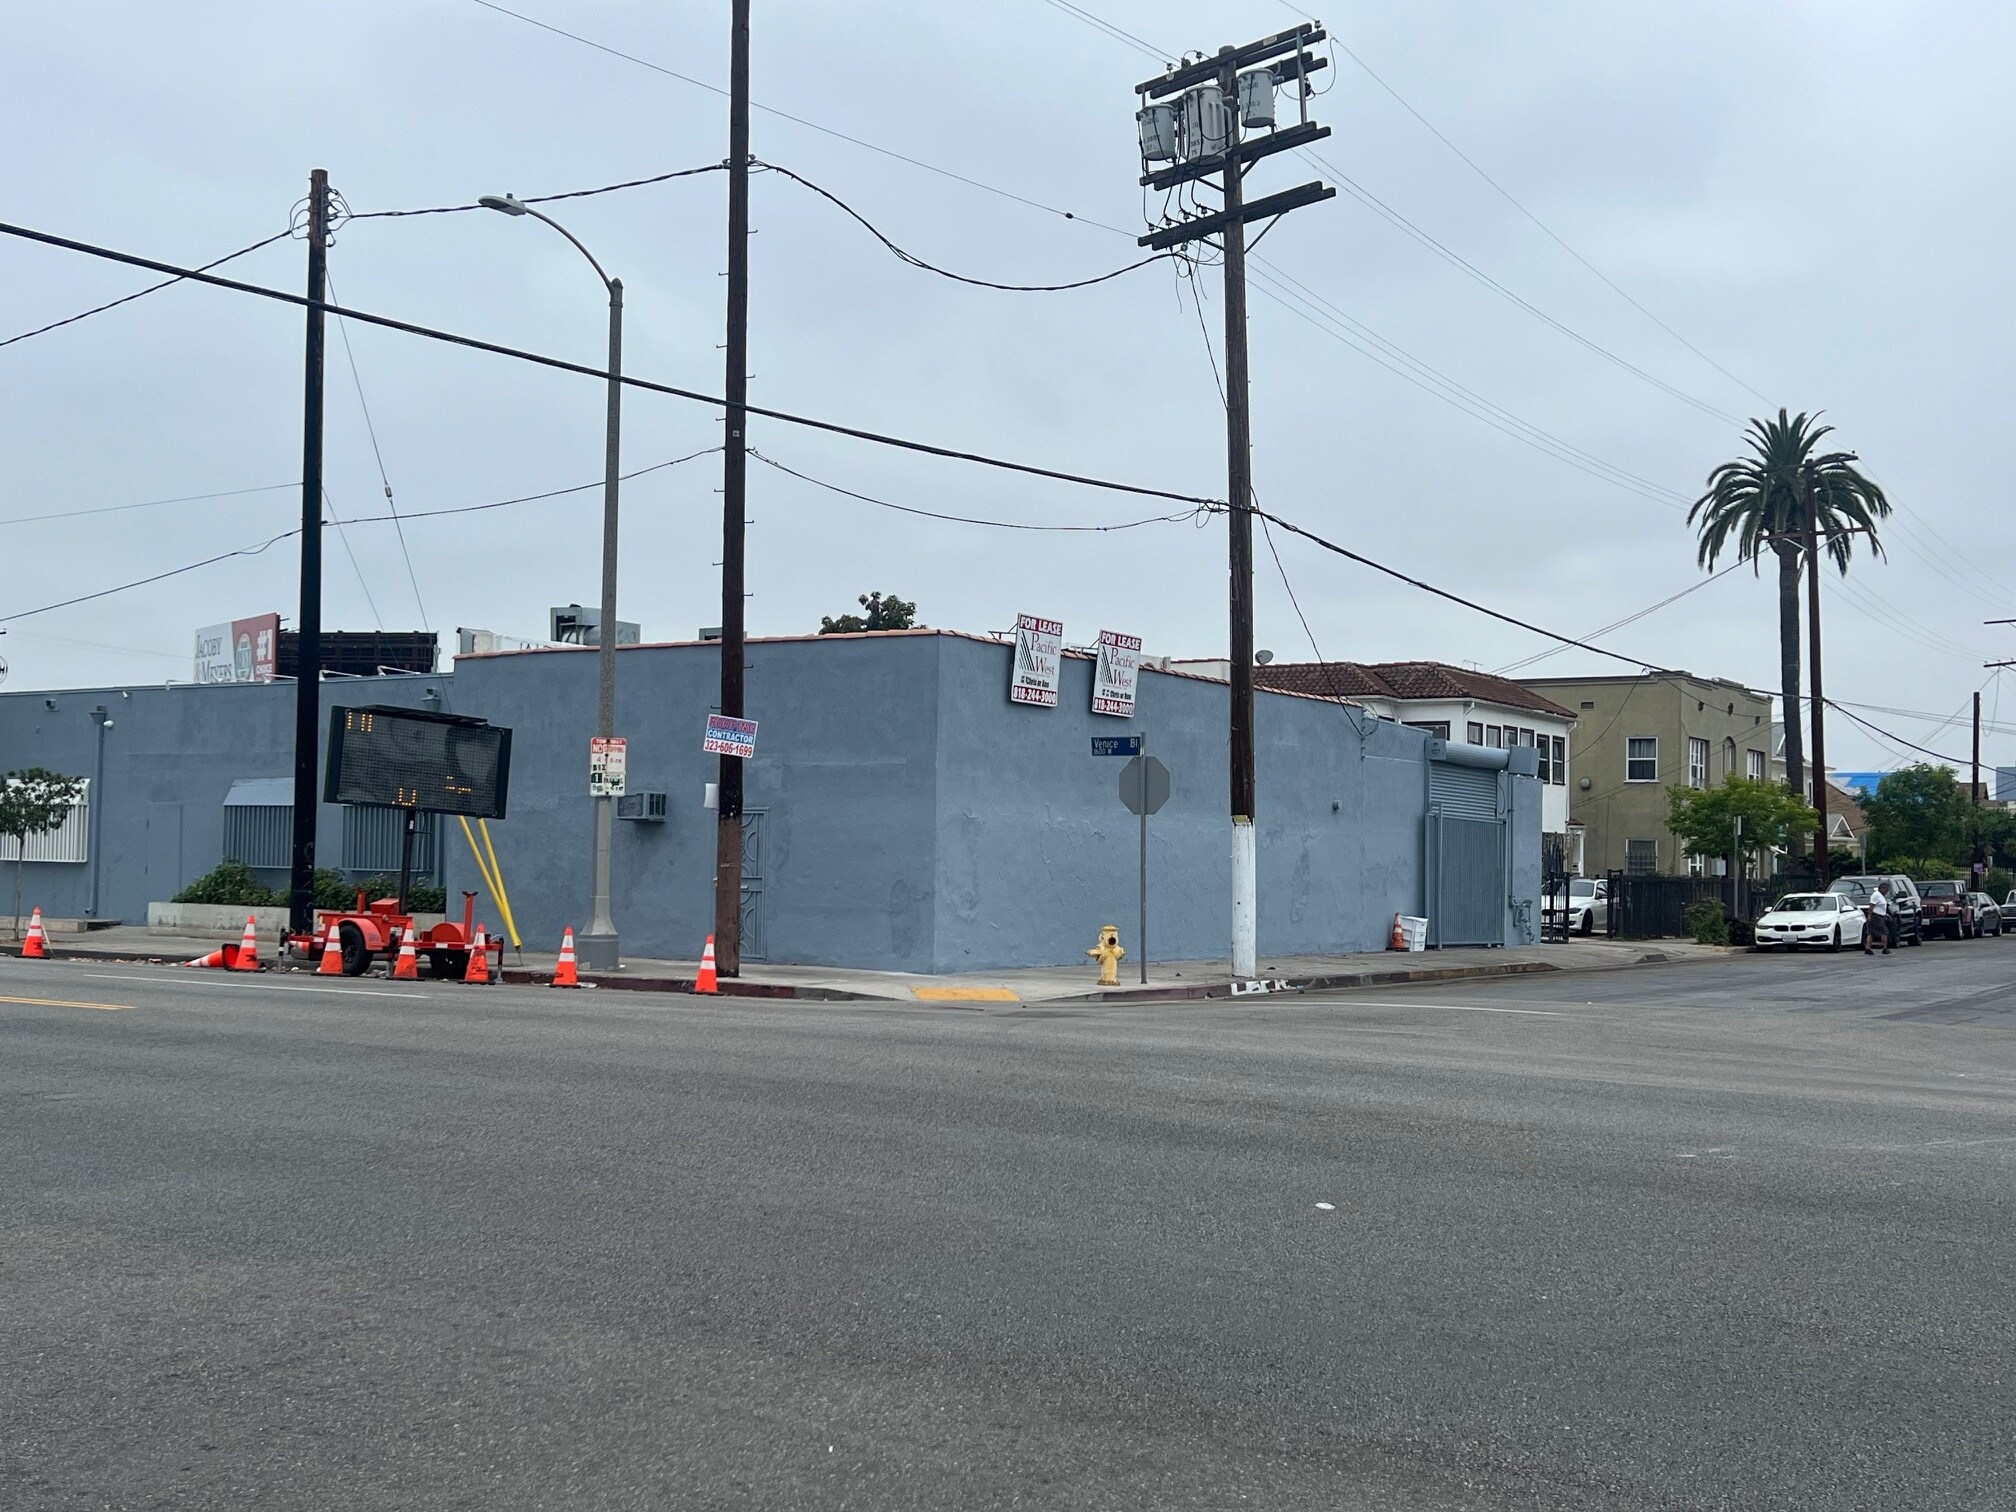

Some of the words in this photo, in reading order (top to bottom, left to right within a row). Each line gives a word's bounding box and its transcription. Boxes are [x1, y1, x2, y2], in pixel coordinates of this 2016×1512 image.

[1020, 616, 1037, 631] FOR
[1038, 619, 1062, 635] LEASE
[196, 634, 223, 659] JACOBY
[1030, 632, 1057, 656] Pacific
[1101, 632, 1116, 646] FOR
[1117, 635, 1141, 650] LEASE
[1035, 655, 1055, 676] West
[1110, 647, 1136, 669] Pacific
[1113, 669, 1132, 687] West
[1013, 686, 1057, 705] 818-244-3000
[1093, 698, 1134, 715] 818-244-3000
[707, 729, 754, 744] CONTRACTOR
[1094, 738, 1119, 749] Venice
